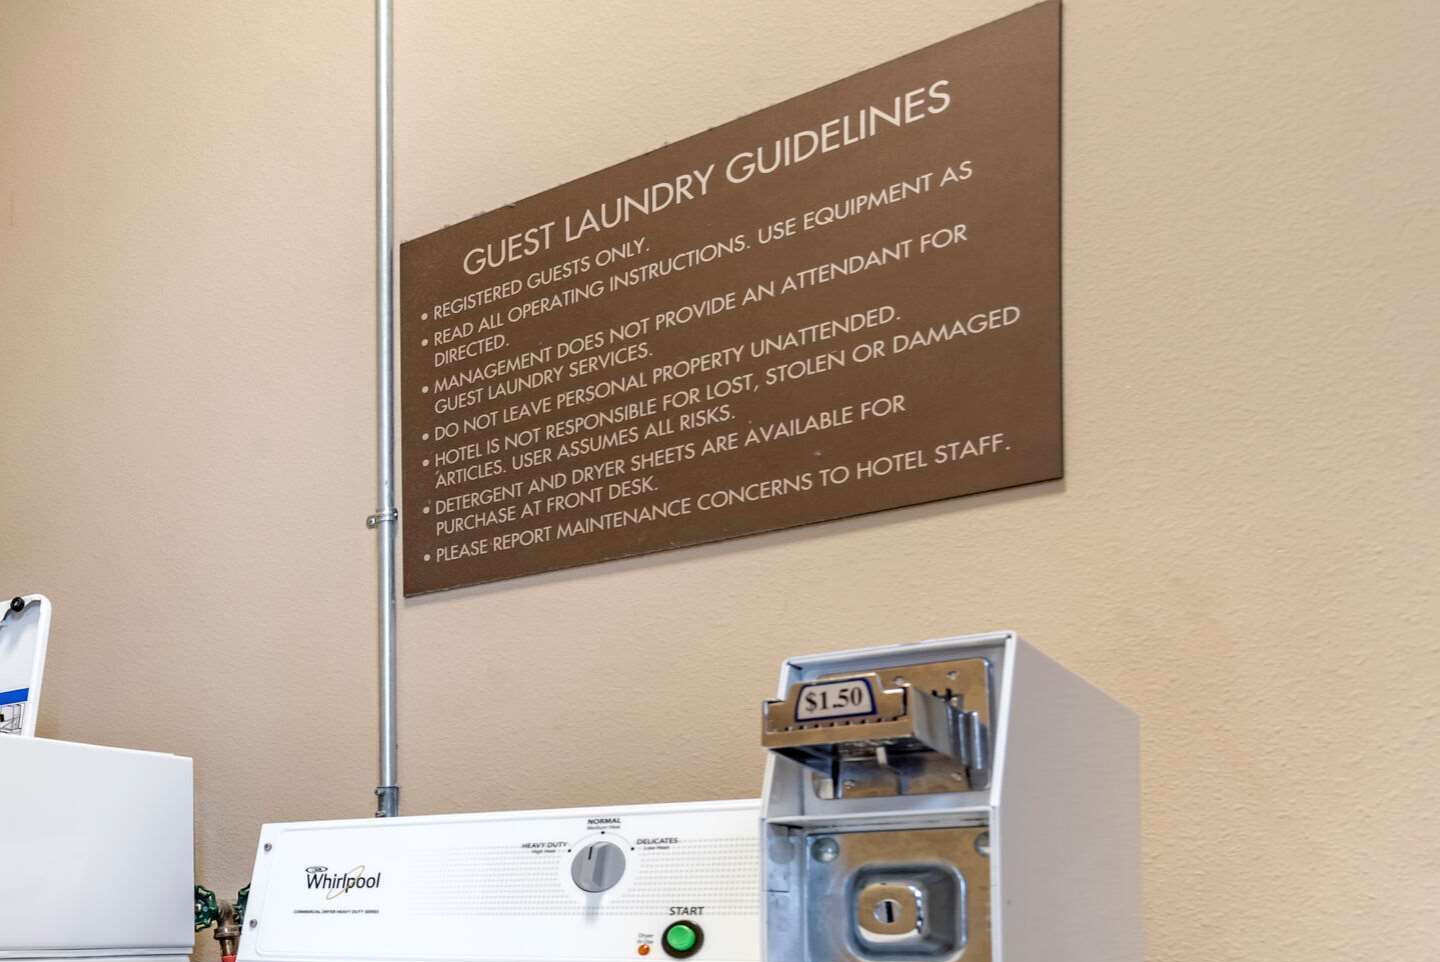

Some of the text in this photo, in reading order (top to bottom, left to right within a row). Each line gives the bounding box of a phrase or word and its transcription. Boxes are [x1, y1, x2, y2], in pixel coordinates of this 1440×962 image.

[463, 80, 951, 275] GUEST LAUNDRY GUIDELINES
[434, 160, 972, 346] READ ALL OPERATING INSTRUCTIONS. USE EQUIPMENT AS
[434, 237, 649, 320] REGISTERED GUESTS ONLY.
[434, 224, 967, 394] MANAGEMENT DOES NOT PROVIDE AN ATTENDANT FOR
[435, 334, 509, 367] DIRECTED.
[434, 342, 653, 414] GUEST LAUNDRY SERVICES.
[435, 306, 901, 441] DO NOT LEAVE PERSONAL PROPERTY UNATTENDED.
[435, 306, 1020, 467] HOTEL IS NOT RESPONSIBLE FOR LOST, STOLEN OR DAMAGED
[435, 404, 735, 489] ARTICLES. USER ASSUMES ALL RISKS.
[435, 394, 906, 515] DETERGENT AND DRYER SHEETS ARE AVAILABLE FOR
[436, 433, 1010, 562] PLEASE REPORT MAINTENANCE CONCERNS TO HOTEL STAFF.
[436, 475, 658, 536] PURCHASE AT FRONT DESK.
[805, 686, 863, 713] $1.50
[306, 871, 381, 894] Whirlpool
[636, 837, 678, 845] DELICATES
[669, 906, 705, 916] START
